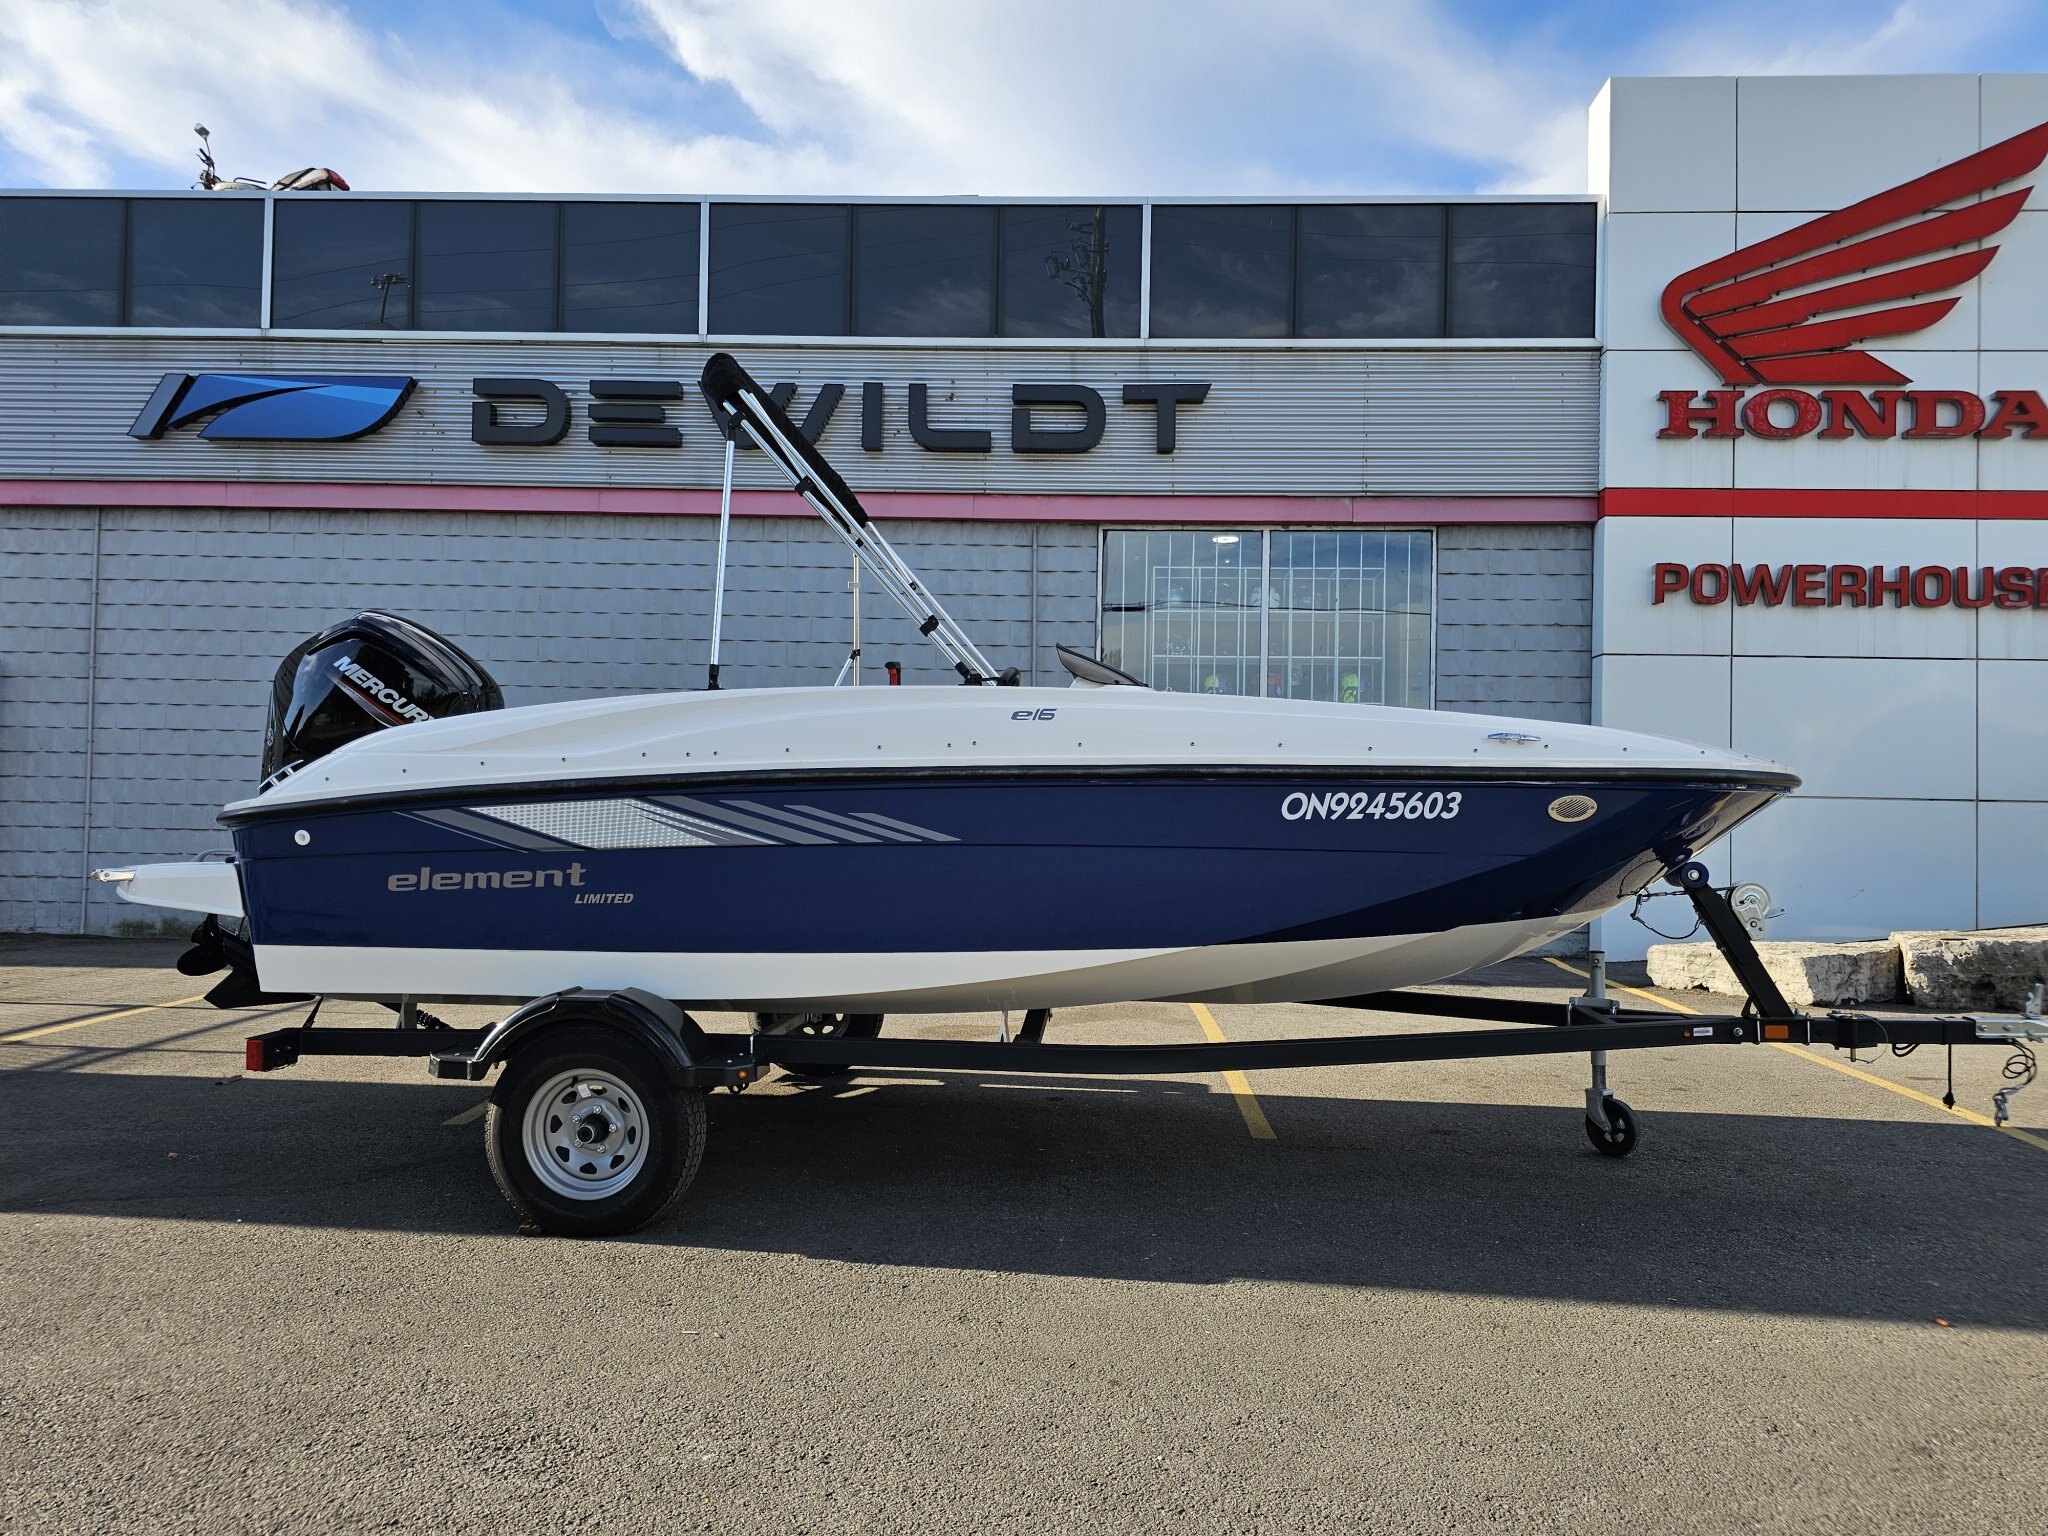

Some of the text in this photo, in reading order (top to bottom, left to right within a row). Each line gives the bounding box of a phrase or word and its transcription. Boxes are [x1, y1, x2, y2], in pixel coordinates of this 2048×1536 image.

[1656, 388, 2048, 440] HONDA
[333, 655, 436, 723] MERCUR
[1281, 791, 1462, 821] ON9245603
[387, 862, 587, 892] element
[574, 893, 634, 904] LIMITED
